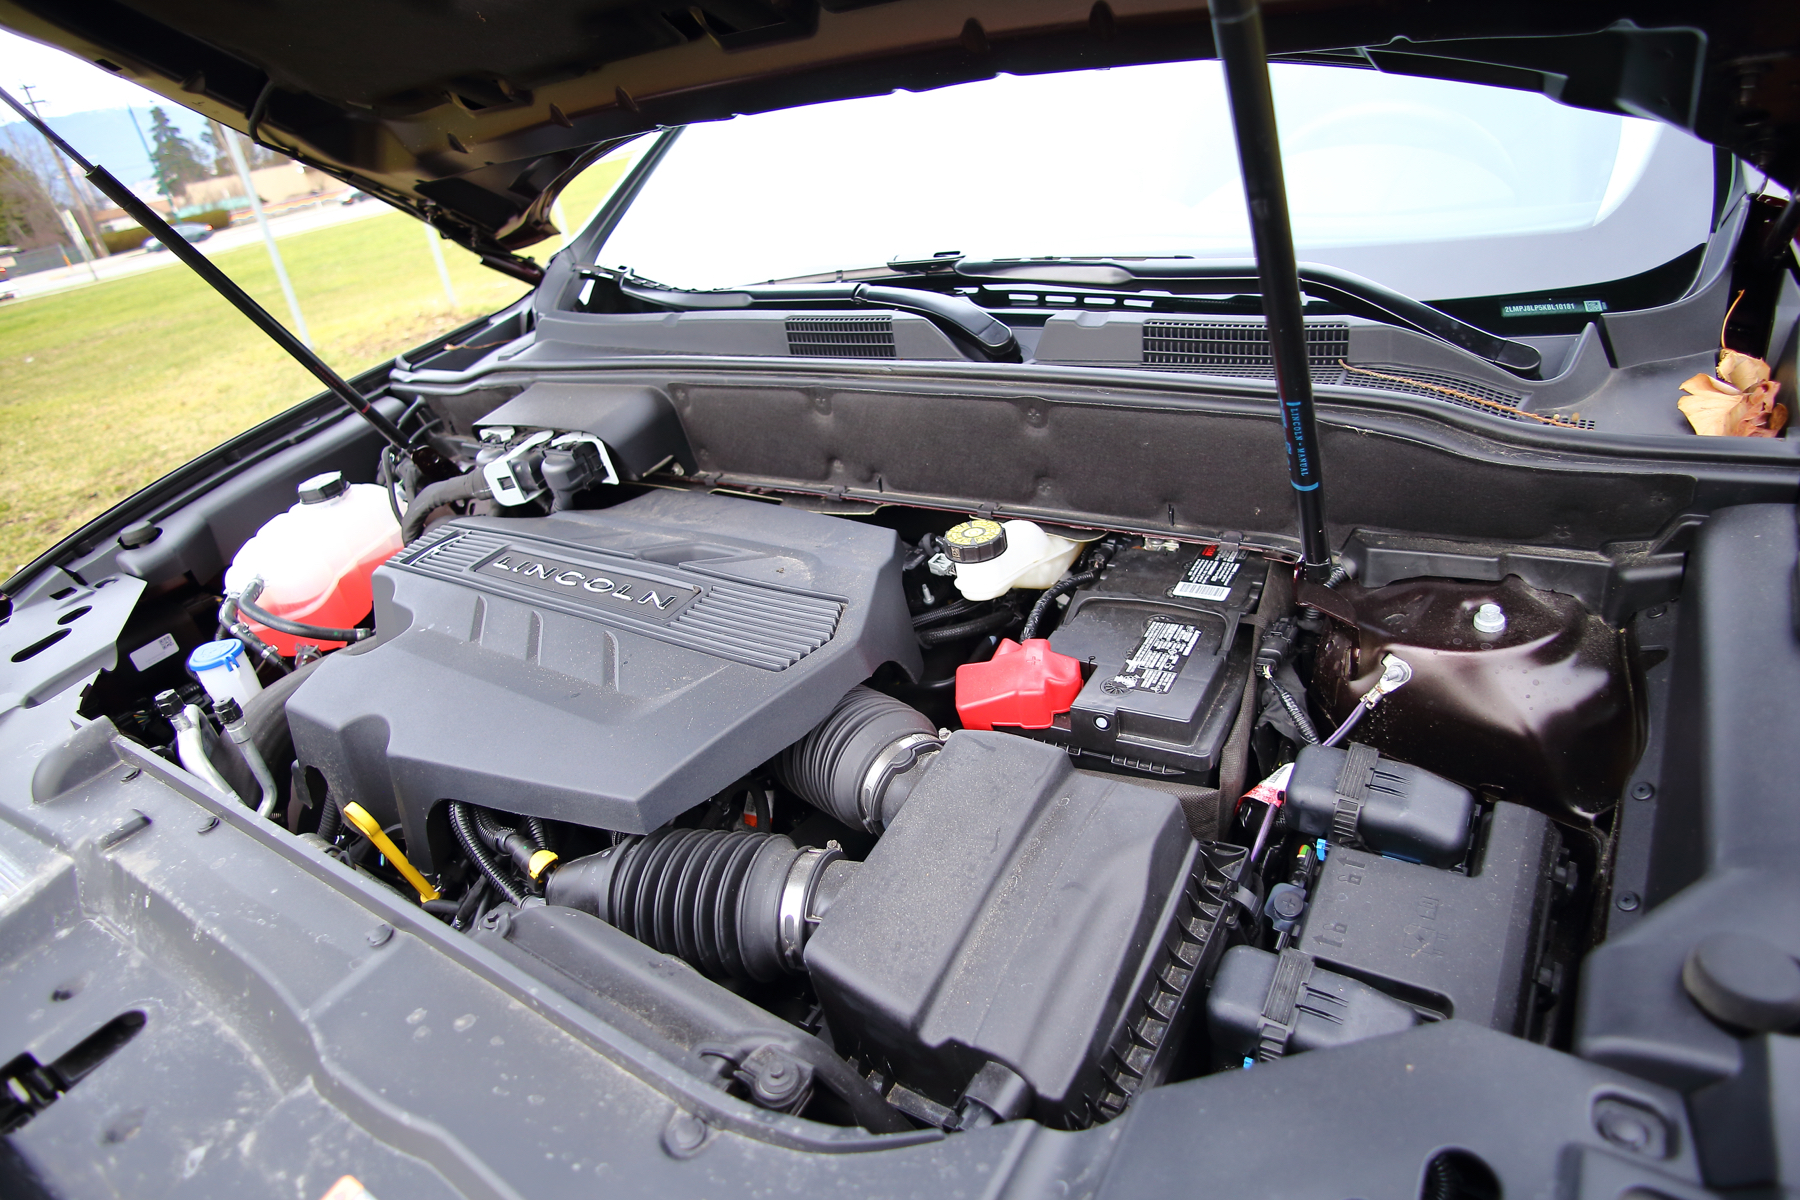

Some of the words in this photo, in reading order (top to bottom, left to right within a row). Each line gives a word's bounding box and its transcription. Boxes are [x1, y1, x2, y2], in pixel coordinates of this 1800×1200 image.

[1290, 408, 1303, 441] LINCOLN
[1297, 447, 1309, 477] MANUAL
[492, 556, 677, 611] LINCOLN
